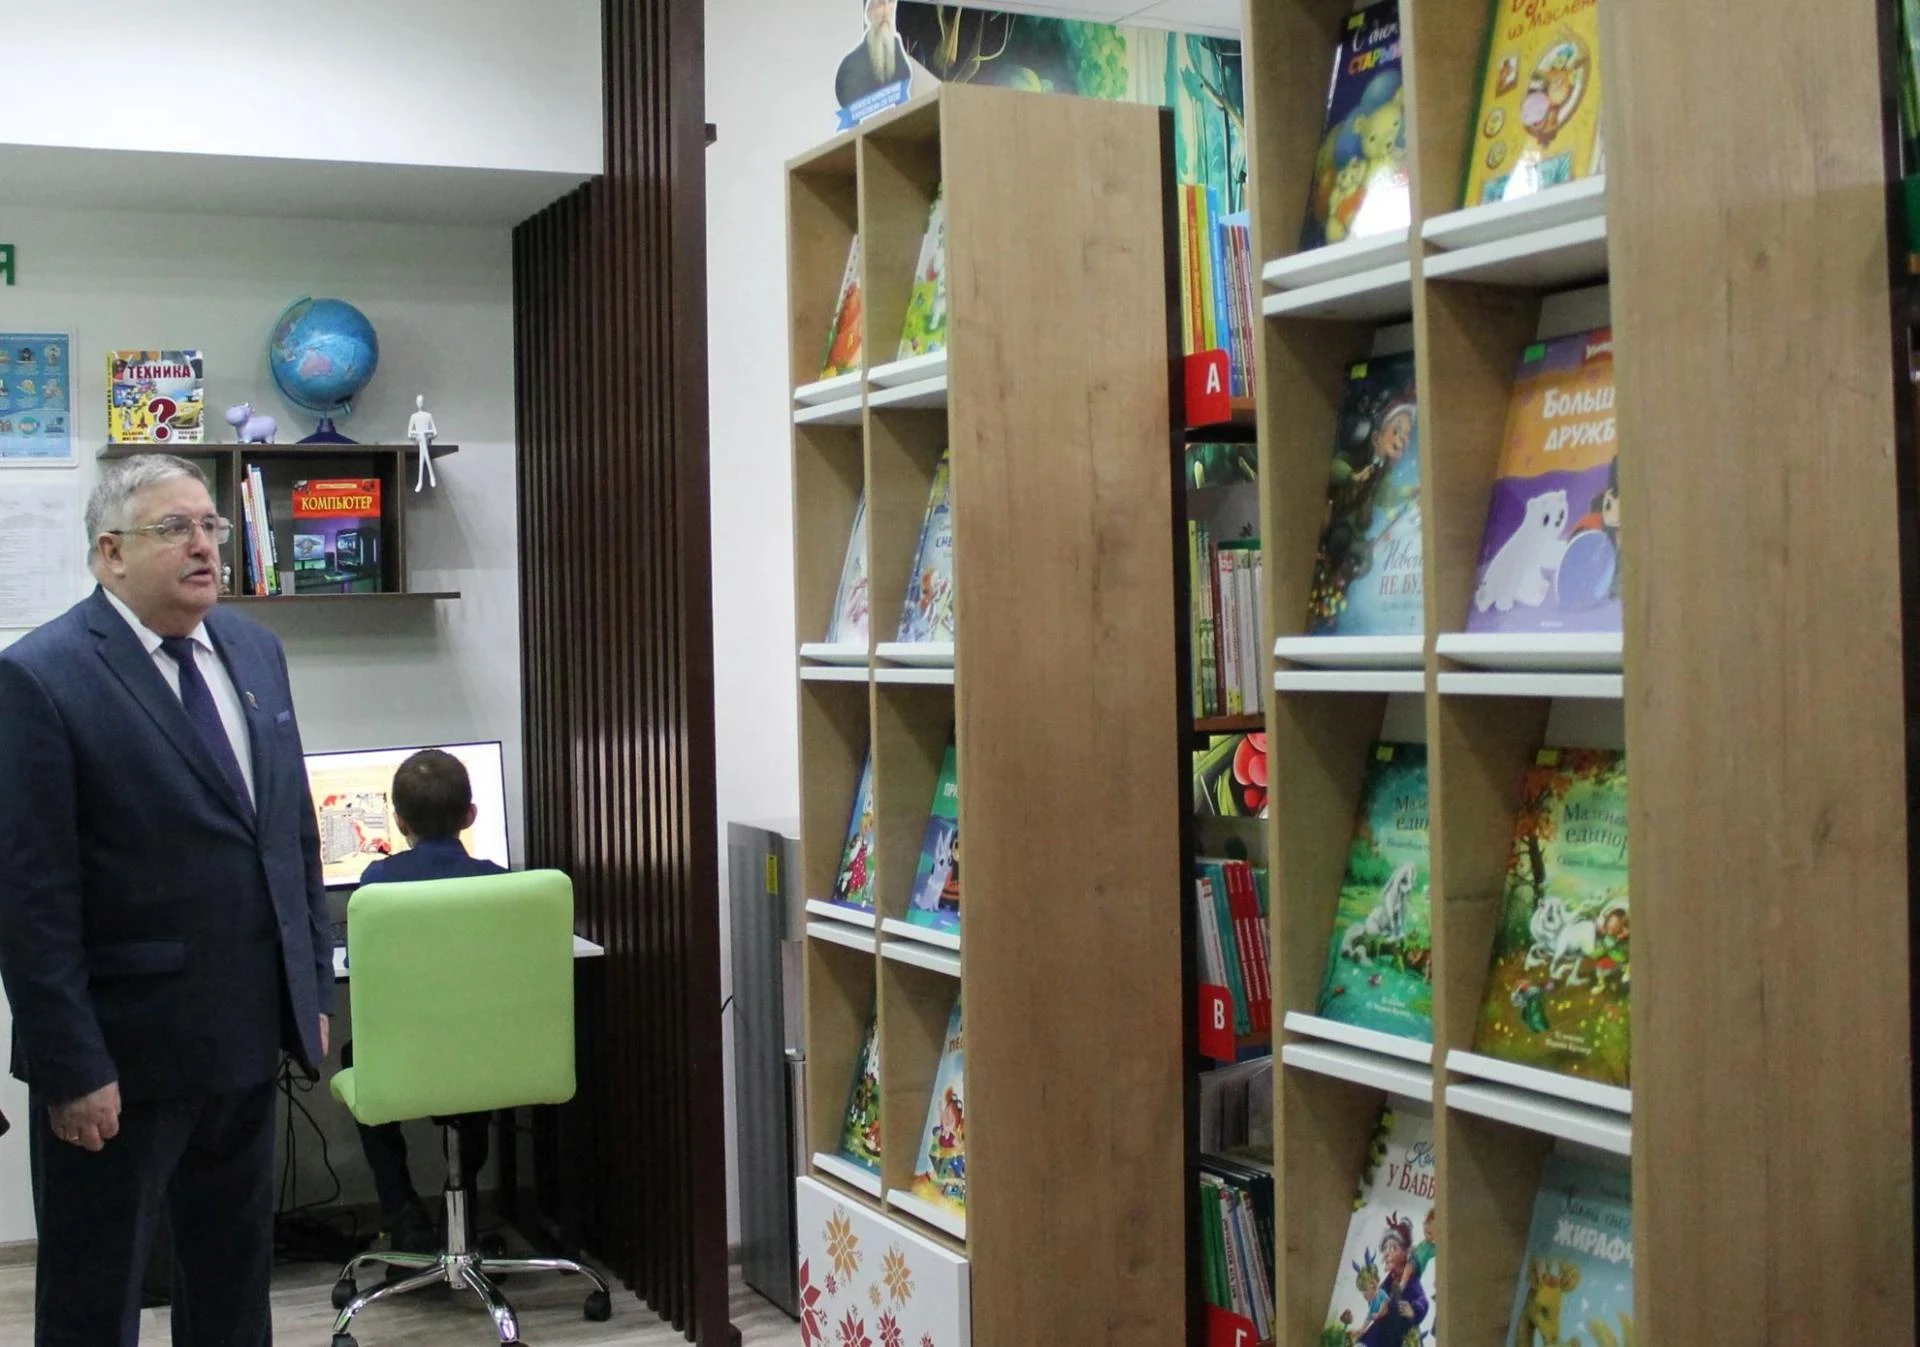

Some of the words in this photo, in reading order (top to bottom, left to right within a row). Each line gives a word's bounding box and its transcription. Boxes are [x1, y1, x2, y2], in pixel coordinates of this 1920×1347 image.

[128, 365, 192, 380] ТЕХНИКА
[1206, 363, 1221, 395] А
[302, 496, 373, 511] КОМПЬЮТЕР
